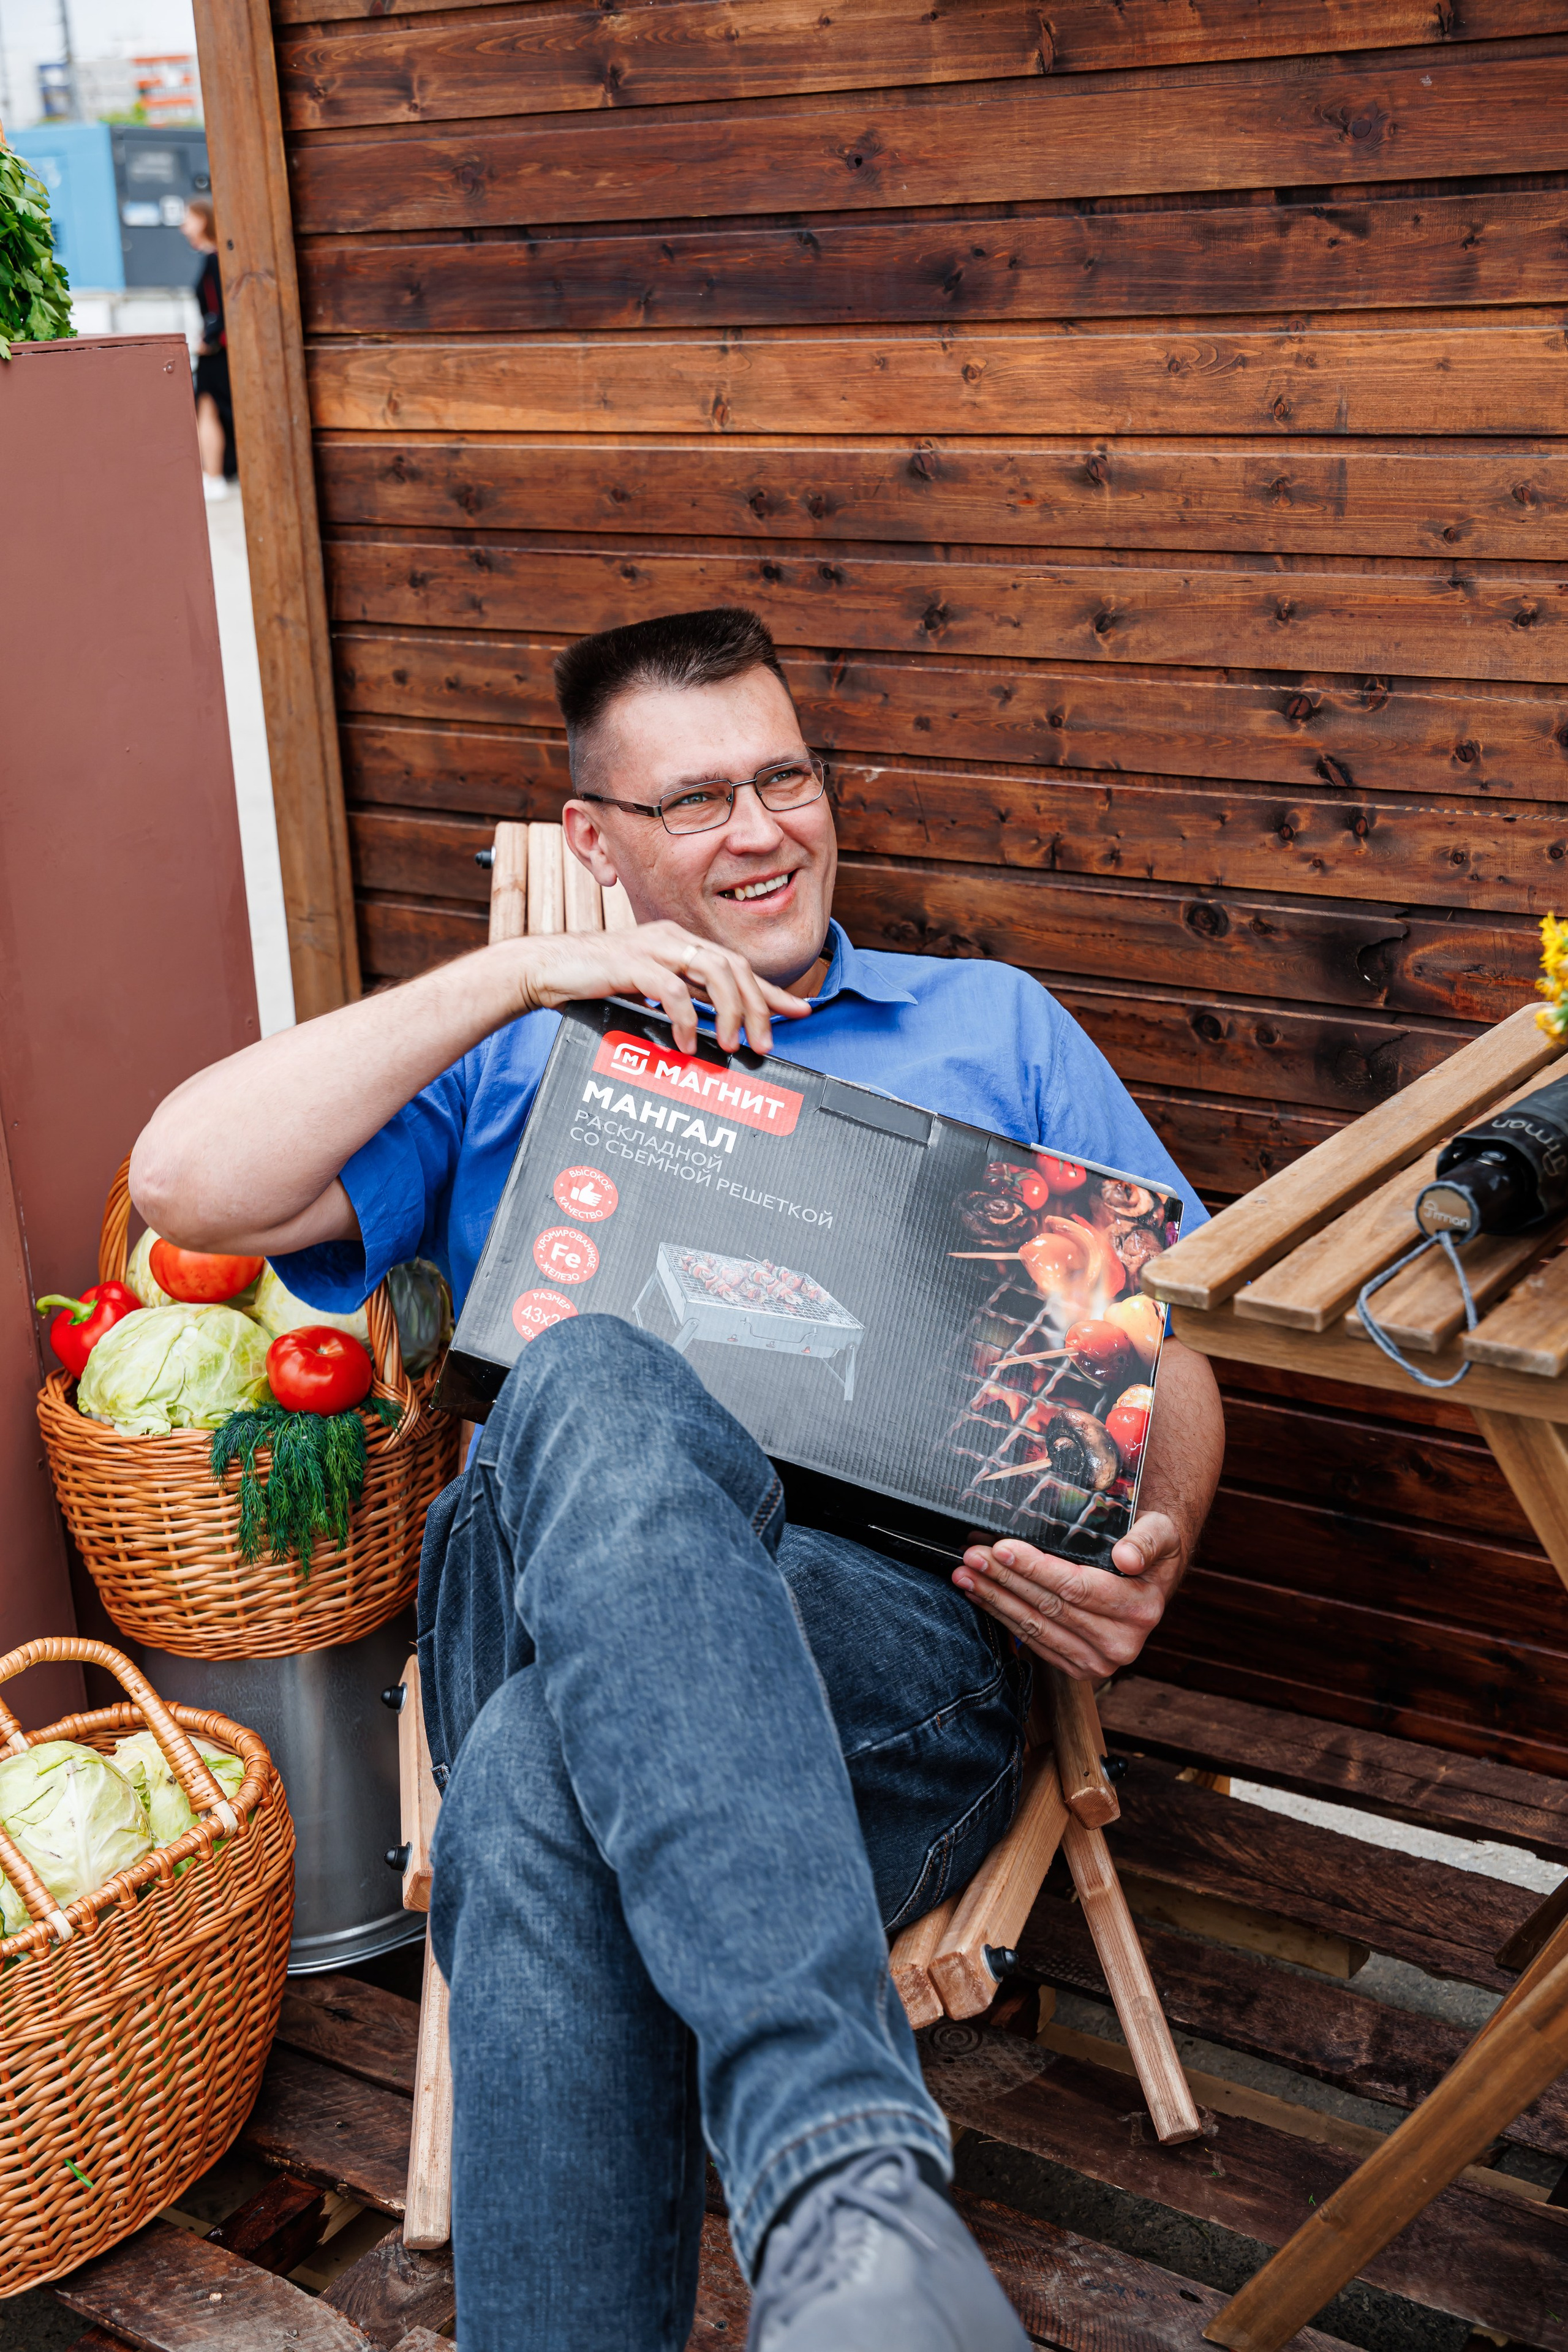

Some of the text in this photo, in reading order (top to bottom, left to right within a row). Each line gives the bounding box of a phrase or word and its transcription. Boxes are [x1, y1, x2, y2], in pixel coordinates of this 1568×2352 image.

[654, 1060, 785, 1120] МАГНИТ
[582, 1080, 737, 1154] МАНГАЛ
[575, 1109, 723, 1173] РАСКЛАДНОЙ
[568, 1169, 612, 1191] ВЫСОКОЕ
[570, 1127, 833, 1229] СО СЪЕМНОЙ РЕШЕТКОЙ
[559, 1196, 603, 1219] КАЧЕСТВО
[537, 1229, 597, 1269] ХРОМИРОВАННОЕ
[551, 1242, 581, 1268] Fe
[540, 1262, 579, 1281] ЖЕЛЕЗО
[532, 1292, 571, 1310] РАЗМЕР
